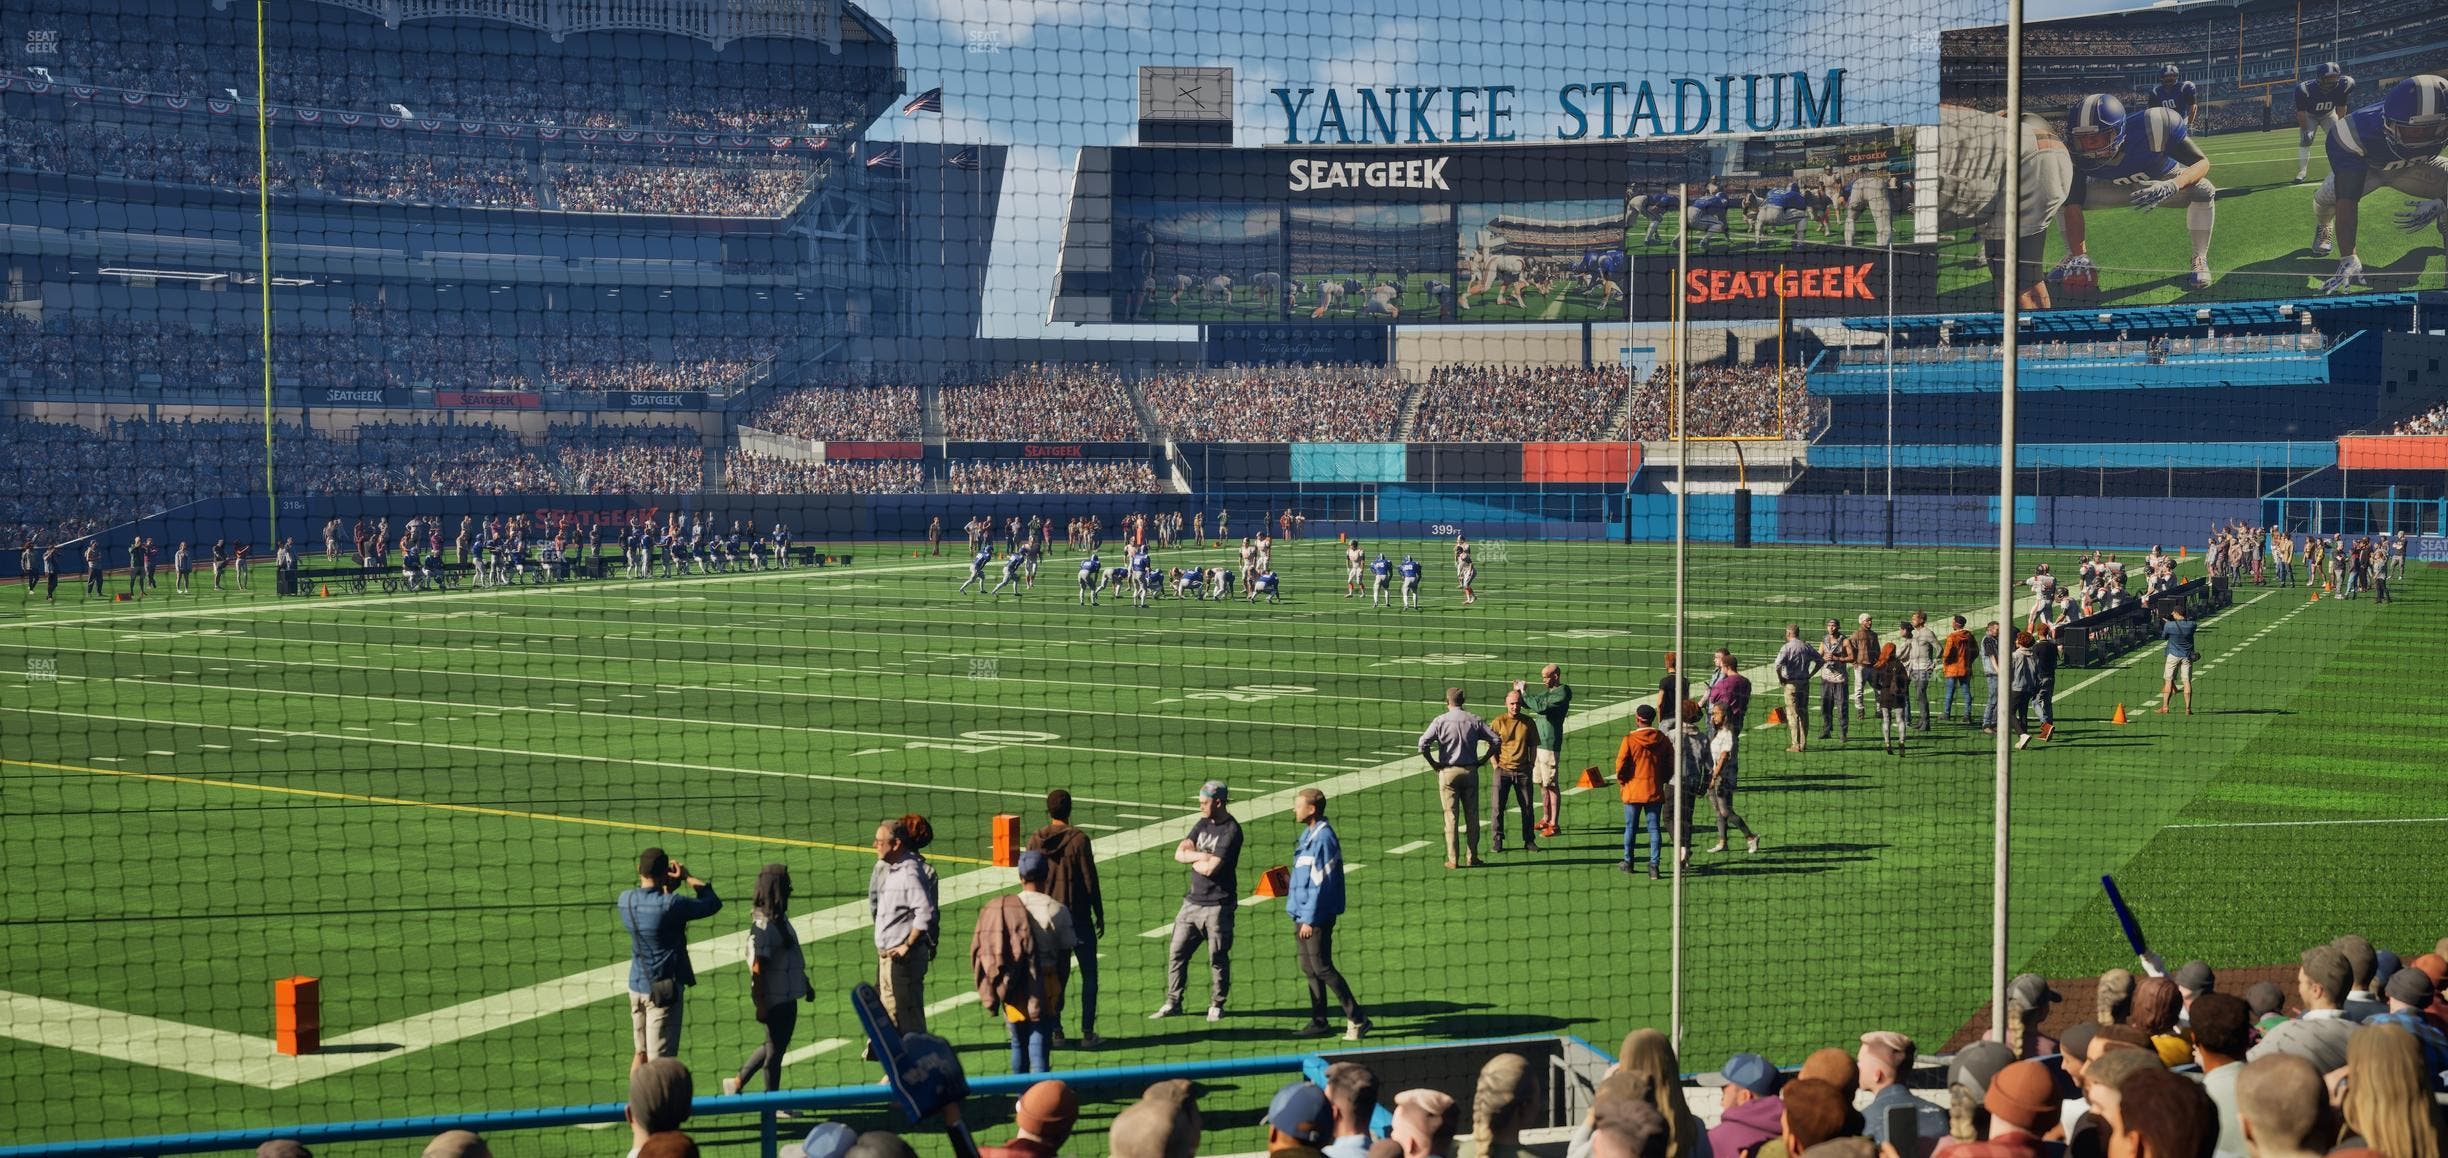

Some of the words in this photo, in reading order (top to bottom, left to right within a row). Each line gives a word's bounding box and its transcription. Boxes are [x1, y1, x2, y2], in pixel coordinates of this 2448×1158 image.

[1270, 85, 1516, 145] YANKEE
[1557, 68, 1848, 140] STADIUM
[1847, 150, 1888, 162] SEATGEEK
[1289, 156, 1450, 192] SEATGEEK
[1686, 262, 1875, 304] SEATGEEK
[326, 388, 383, 402] SEATGEEK
[460, 394, 515, 406] SEATGEEK
[630, 394, 684, 406] SEATGEEK
[1024, 445, 1082, 457] SEATGEEK
